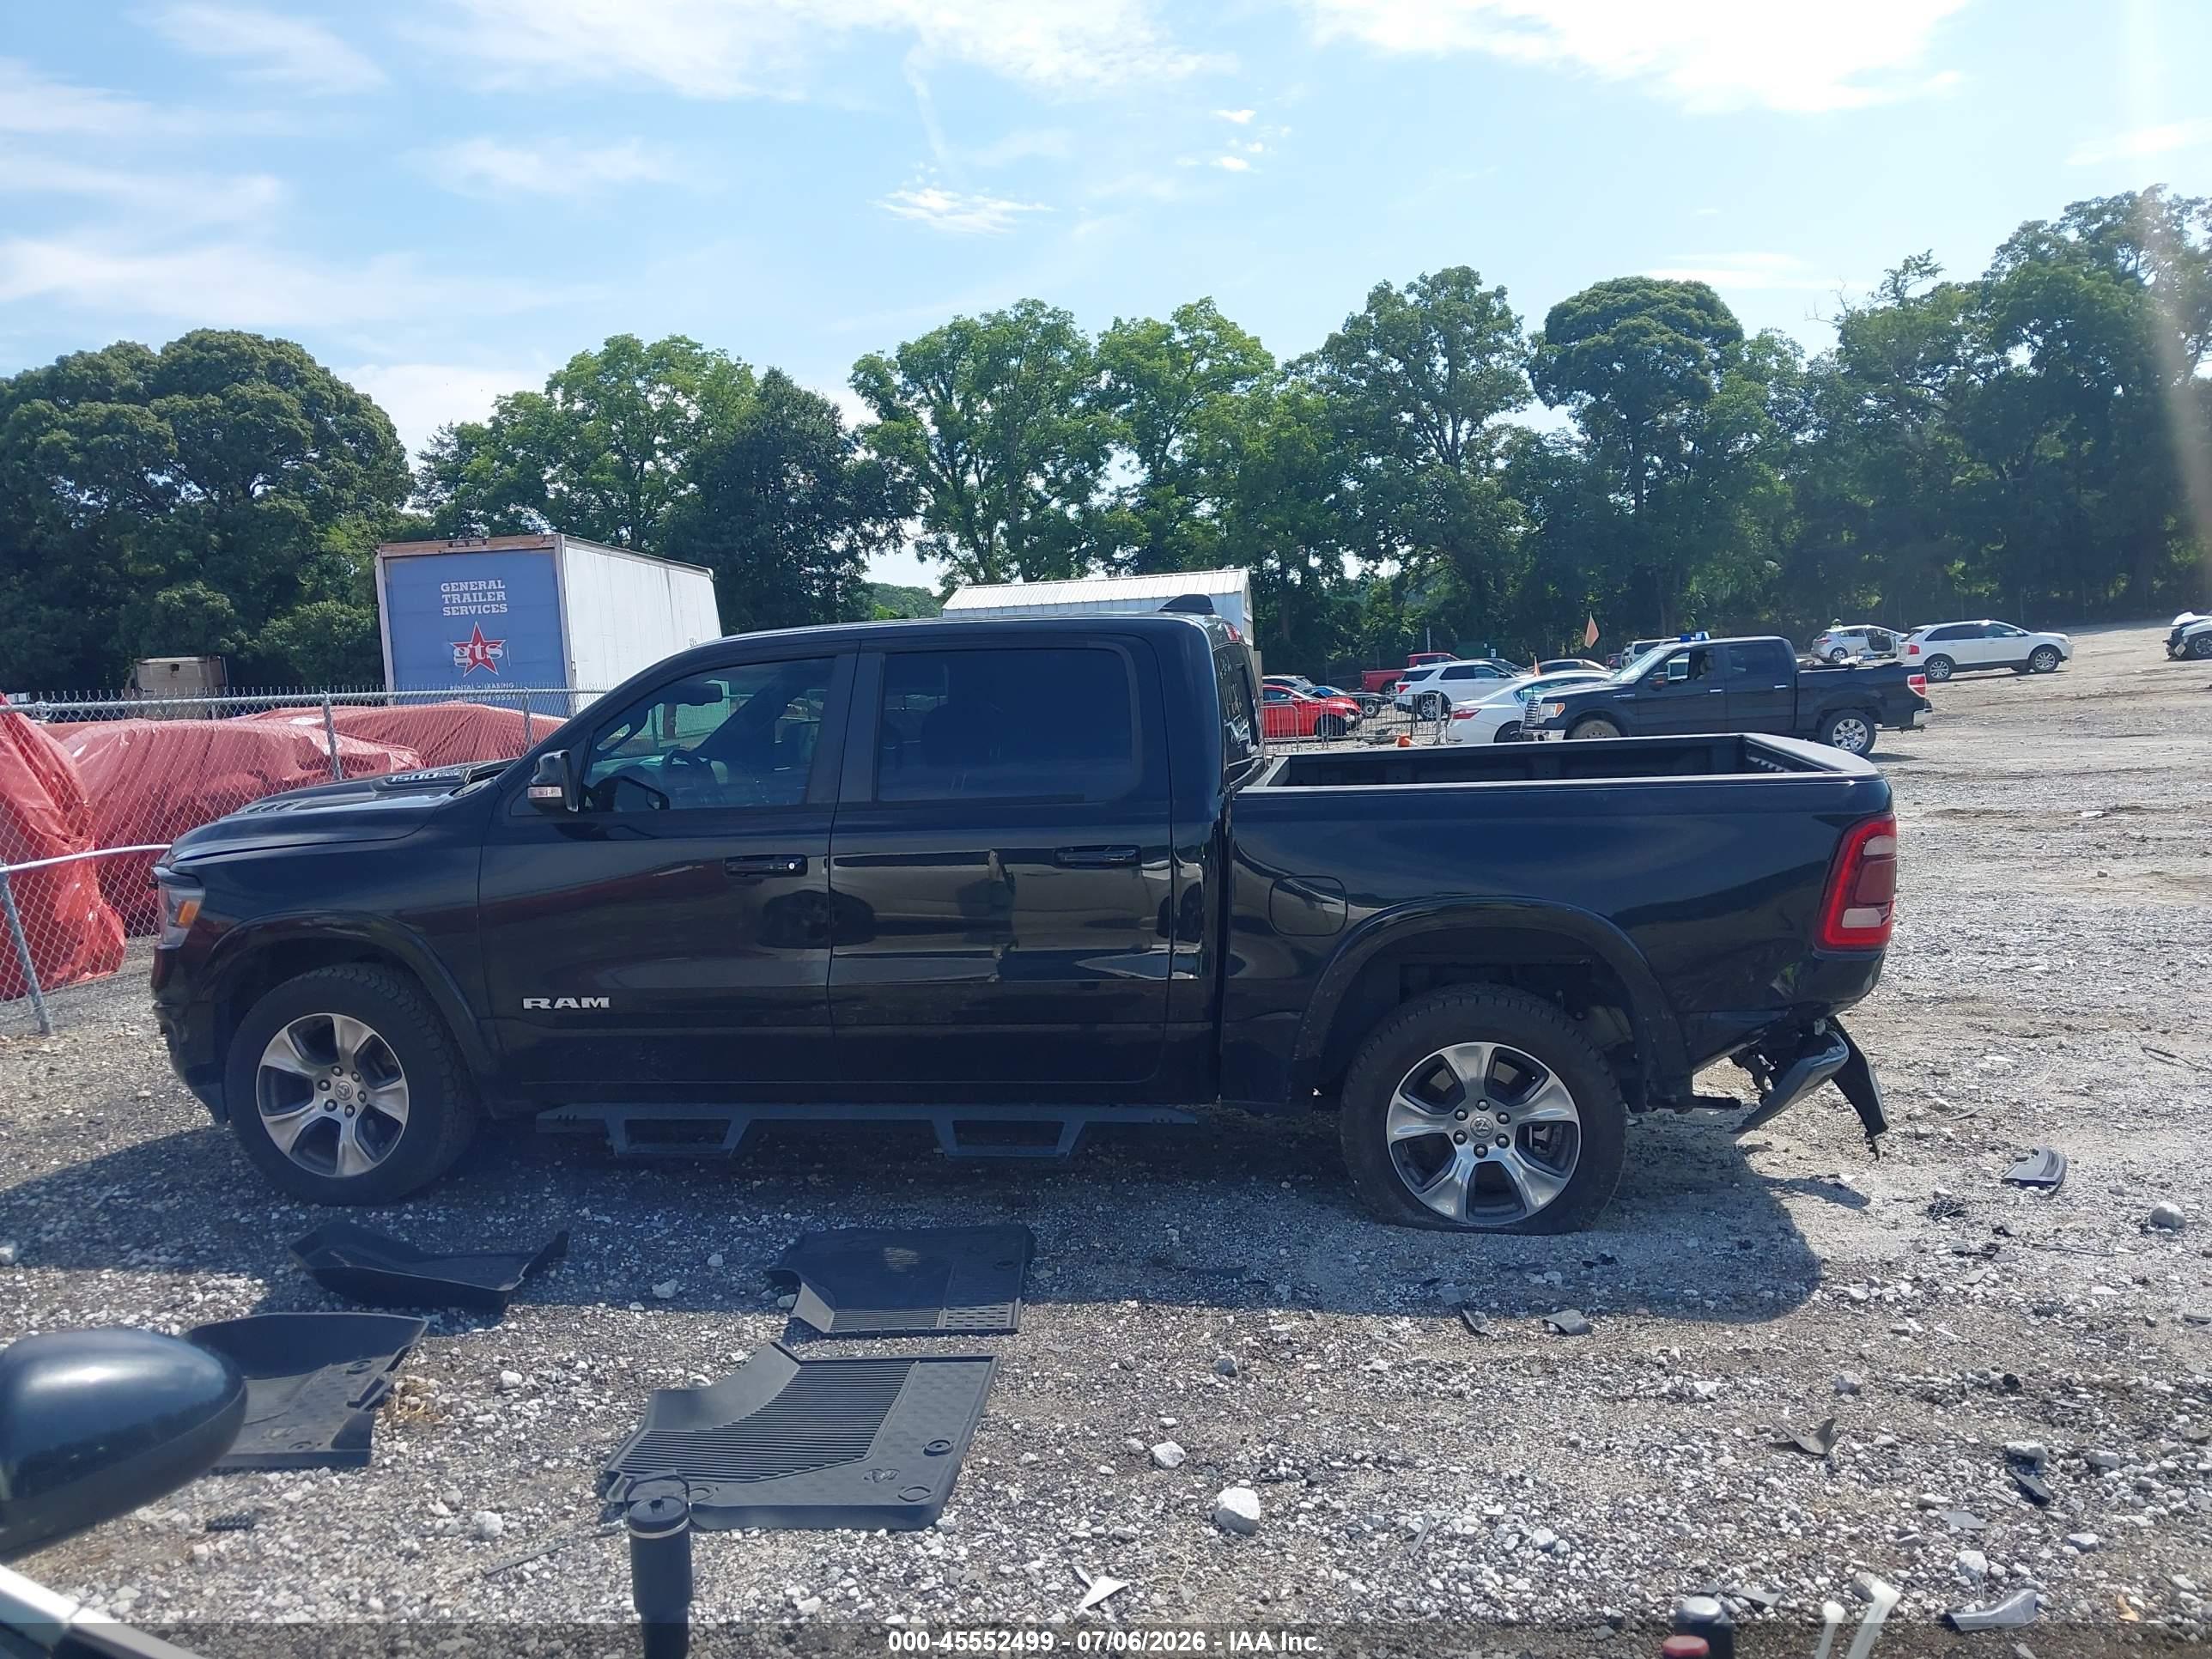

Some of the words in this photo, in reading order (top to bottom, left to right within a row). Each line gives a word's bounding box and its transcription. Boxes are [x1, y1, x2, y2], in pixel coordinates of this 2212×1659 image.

[441, 580, 506, 592] GENERAL
[441, 591, 507, 604] TRAILER
[442, 603, 508, 617] SERVICES
[453, 641, 503, 668] gts
[391, 772, 439, 783] 1500
[522, 997, 611, 1010] RAM
